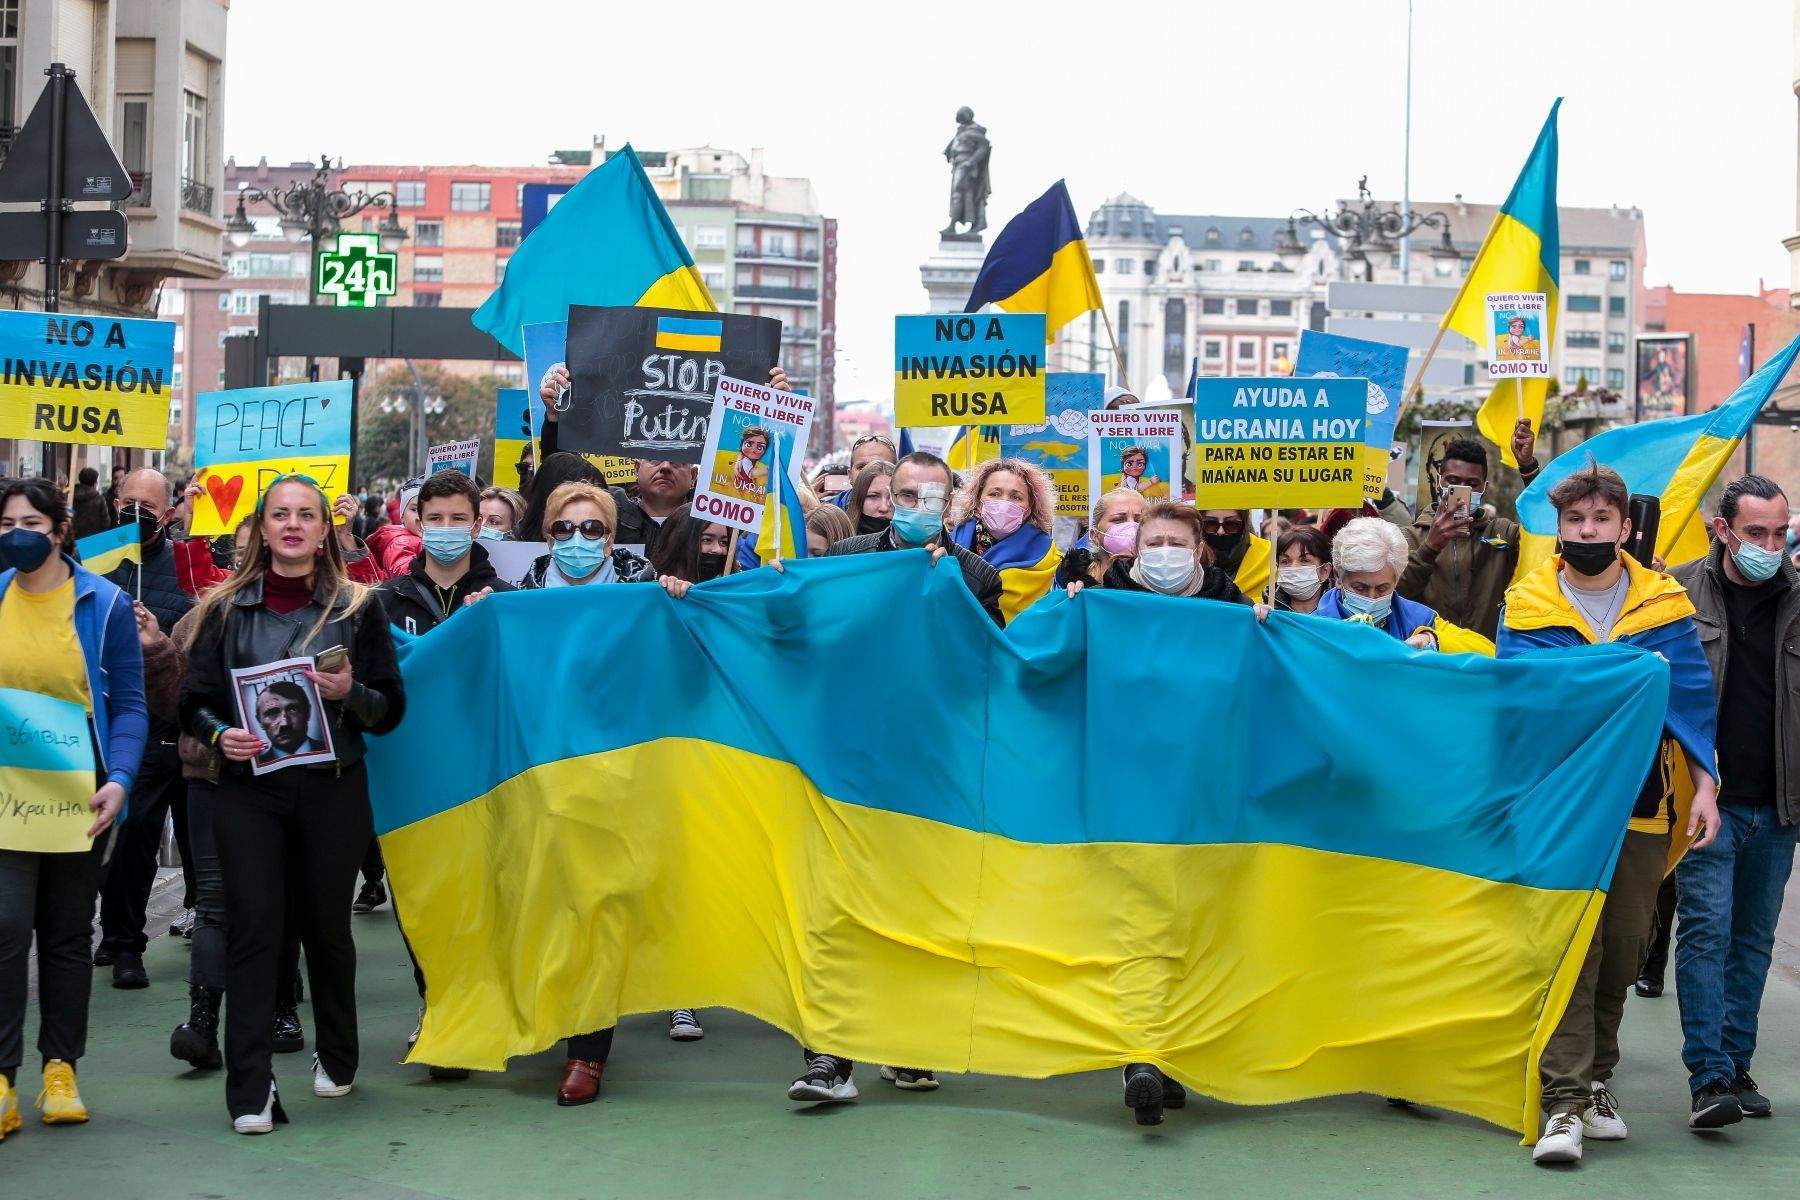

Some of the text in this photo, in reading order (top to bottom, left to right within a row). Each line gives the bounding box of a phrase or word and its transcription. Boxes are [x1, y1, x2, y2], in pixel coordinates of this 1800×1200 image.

[323, 260, 389, 292] 24h
[46, 318, 126, 349] NO A
[935, 318, 1004, 341] NO A
[642, 354, 726, 392] STOP
[902, 349, 1037, 380] INVASIÓN
[1490, 363, 1547, 374] COMO TU
[4, 358, 163, 394] INVASIÓN
[720, 381, 813, 412] QUIERO VIVIR
[932, 392, 1008, 416] RUSA
[1233, 388, 1329, 407] AYUDA A
[35, 404, 124, 435] RUSA
[722, 396, 805, 425] Y SER LIBRE
[1091, 413, 1179, 423] QUIERO VIVIR
[213, 396, 319, 453] PEACE
[1096, 427, 1174, 436] Y SER LIBRE
[1201, 418, 1361, 440] UCRANIA HOY
[430, 442, 479, 455] QUIERO VIVIR
[454, 451, 475, 460] LIBRE
[1205, 447, 1354, 461] PARA NO ESTAR EN
[604, 458, 635, 468] EL RES
[603, 469, 635, 479] OSOTR
[1202, 466, 1352, 483] MAÑANA SU LUGAR
[733, 478, 766, 495] UKRAI
[1055, 504, 1089, 512] OSOTR
[1060, 494, 1089, 502] EL RES
[695, 494, 755, 524] COMO
